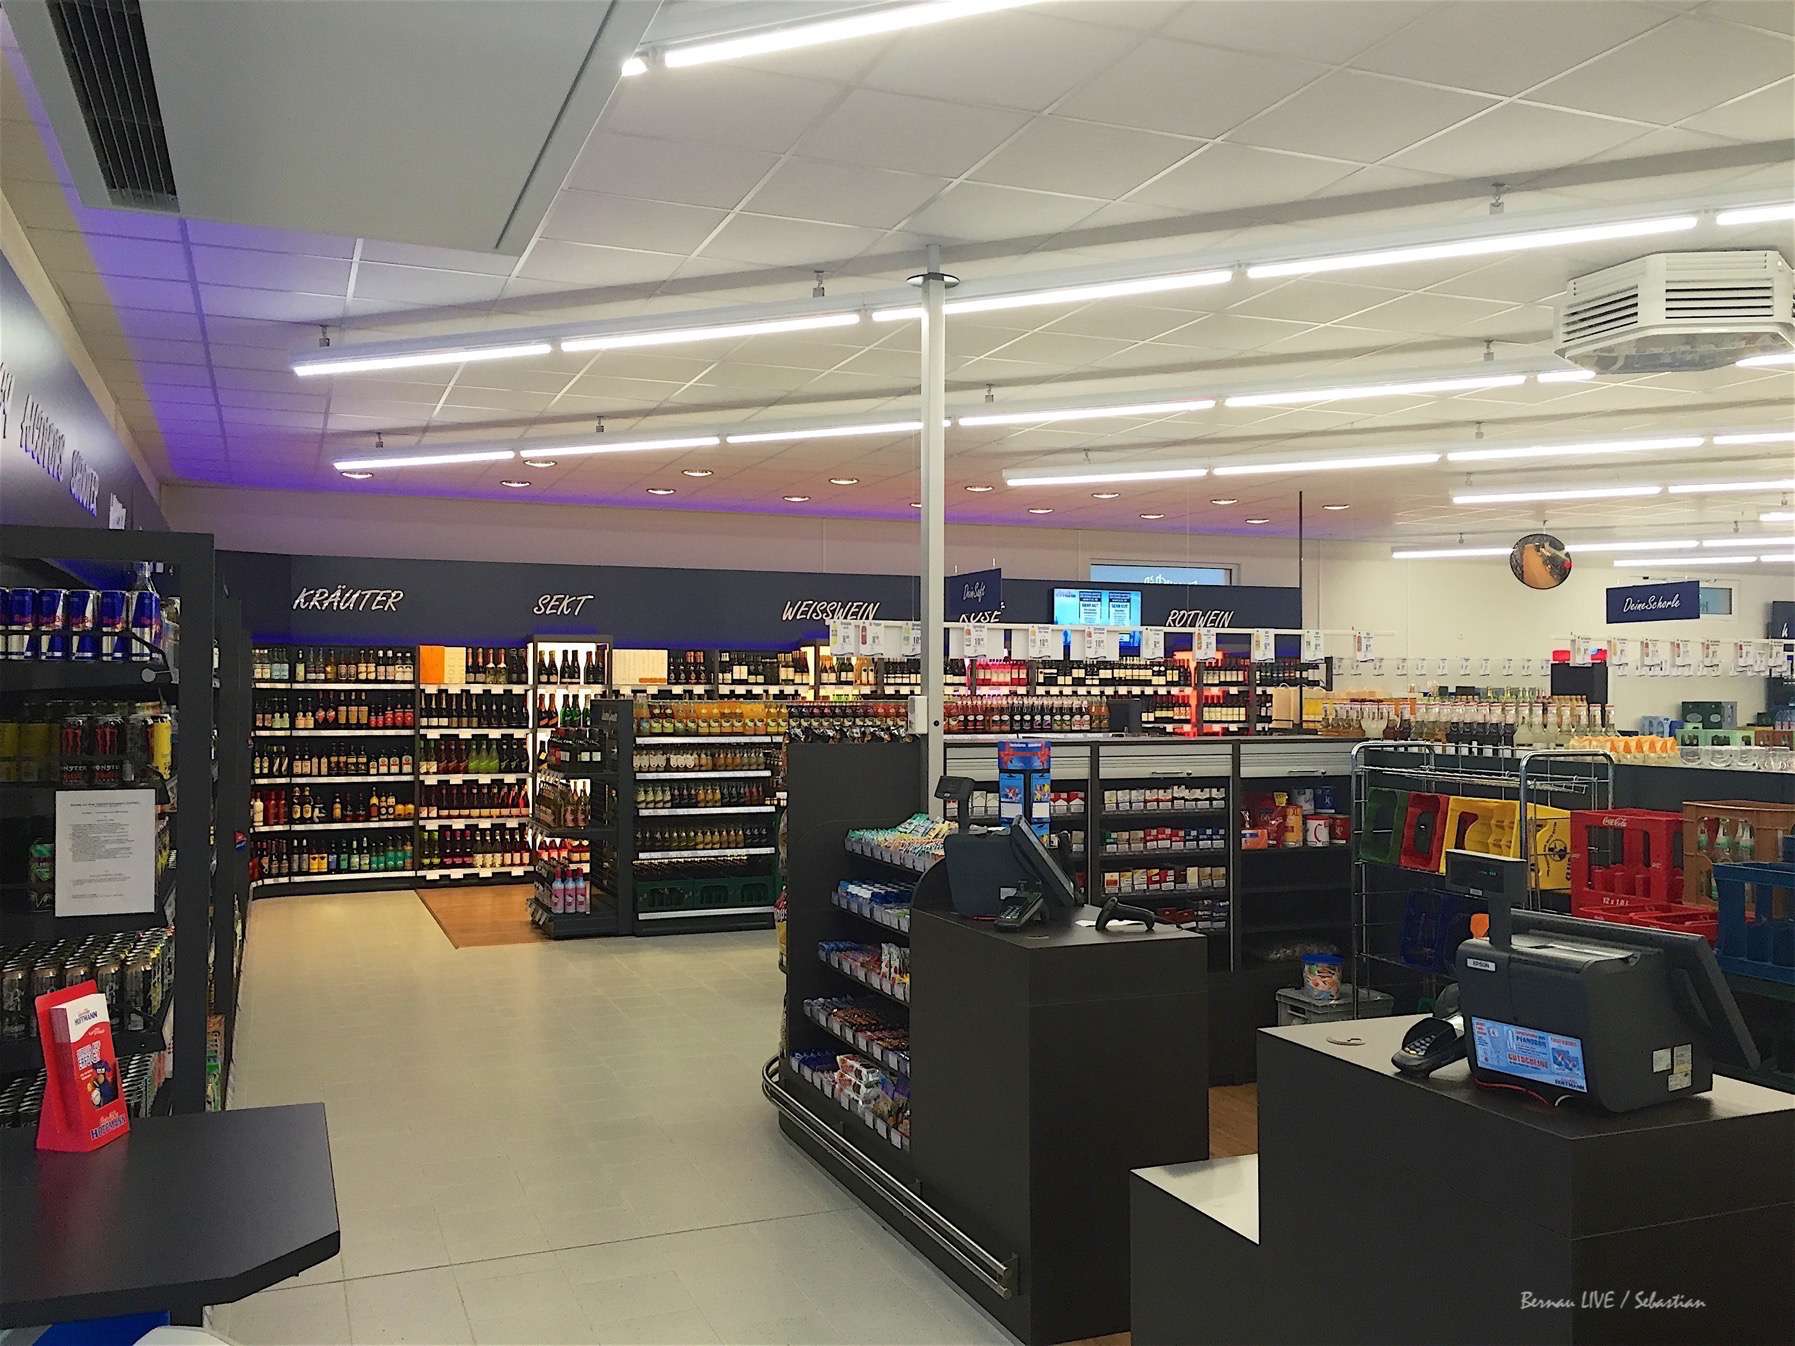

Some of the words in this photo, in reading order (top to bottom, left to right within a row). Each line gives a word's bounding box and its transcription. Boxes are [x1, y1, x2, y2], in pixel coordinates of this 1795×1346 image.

[292, 584, 405, 613] KRÄUTER
[533, 593, 596, 616] SEKT
[781, 600, 881, 621] WEISSWEIN
[1165, 609, 1235, 628] ROTWEIN
